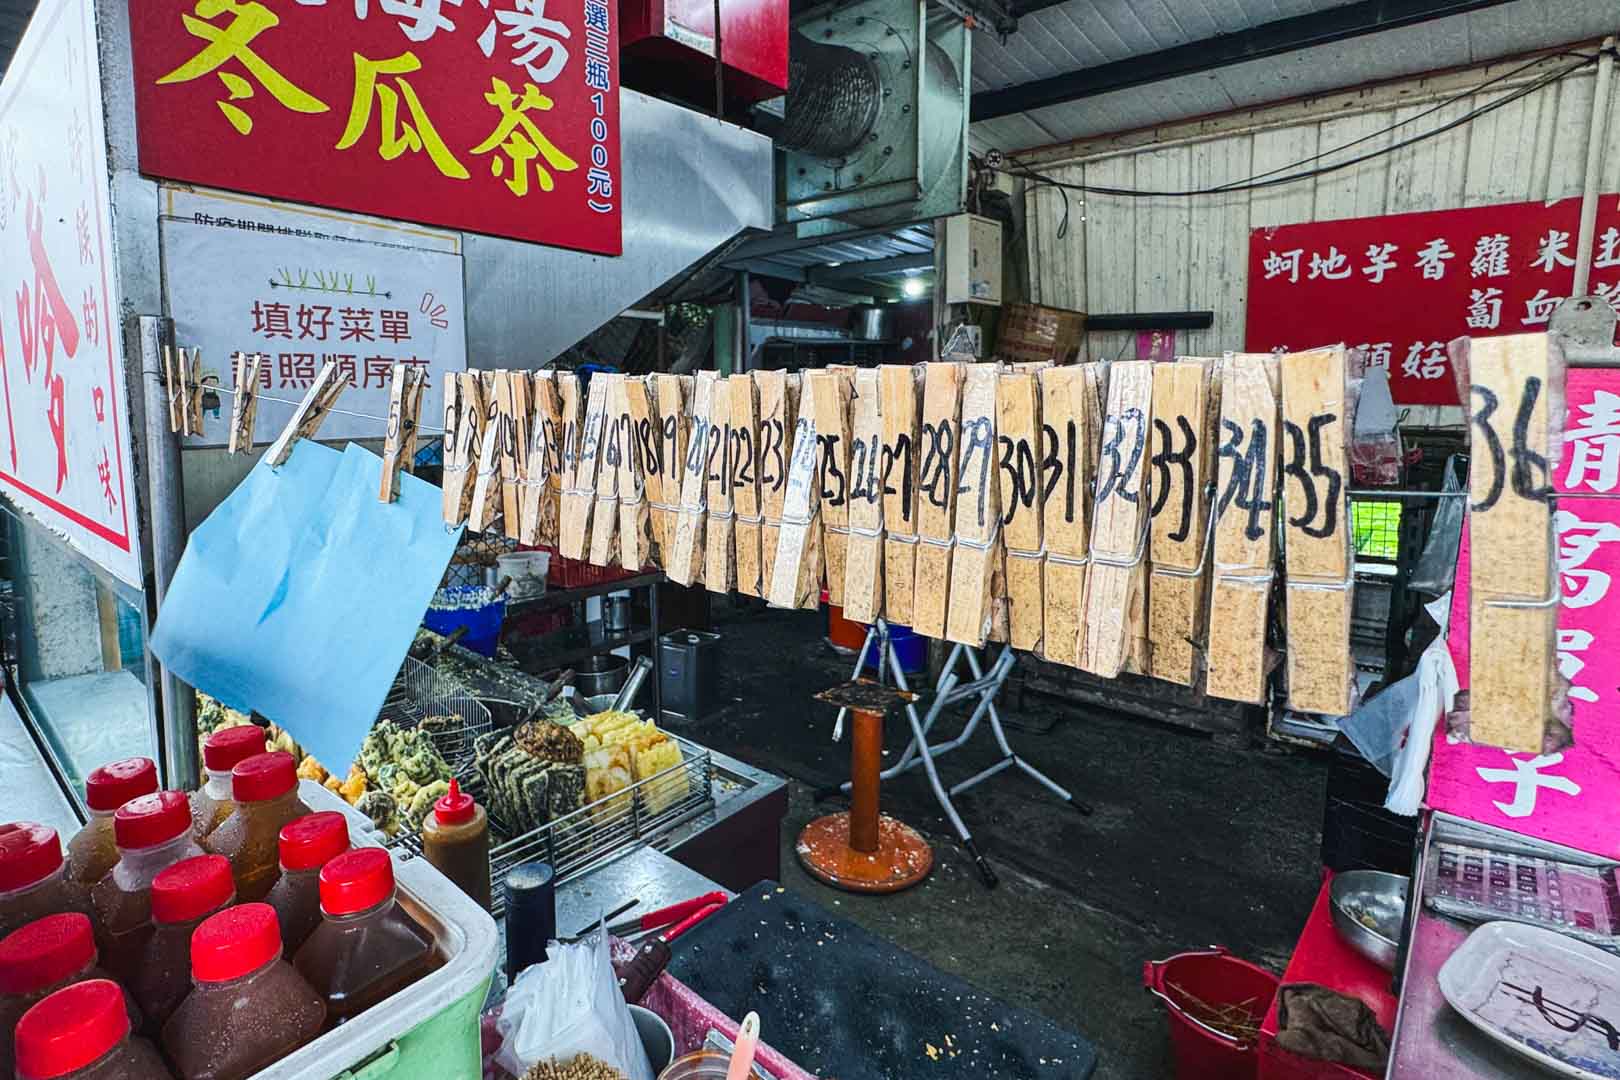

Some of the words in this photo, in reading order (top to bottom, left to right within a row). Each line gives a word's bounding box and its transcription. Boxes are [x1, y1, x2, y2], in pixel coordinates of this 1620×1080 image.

[155, 0, 579, 197] 冬瓜茶
[250, 300, 412, 344] 填好菜單
[708, 422, 729, 496] 21
[761, 418, 785, 492] 23
[815, 433, 846, 507] 25
[882, 433, 912, 522] 27
[920, 418, 954, 516] 28
[957, 415, 993, 527] 29
[999, 435, 1036, 525] 30
[1043, 419, 1076, 524] 31
[1095, 407, 1145, 505] 32
[1151, 415, 1197, 542] 33
[1217, 416, 1272, 541] 34
[1285, 412, 1342, 539] 35
[1469, 376, 1557, 513] 36
